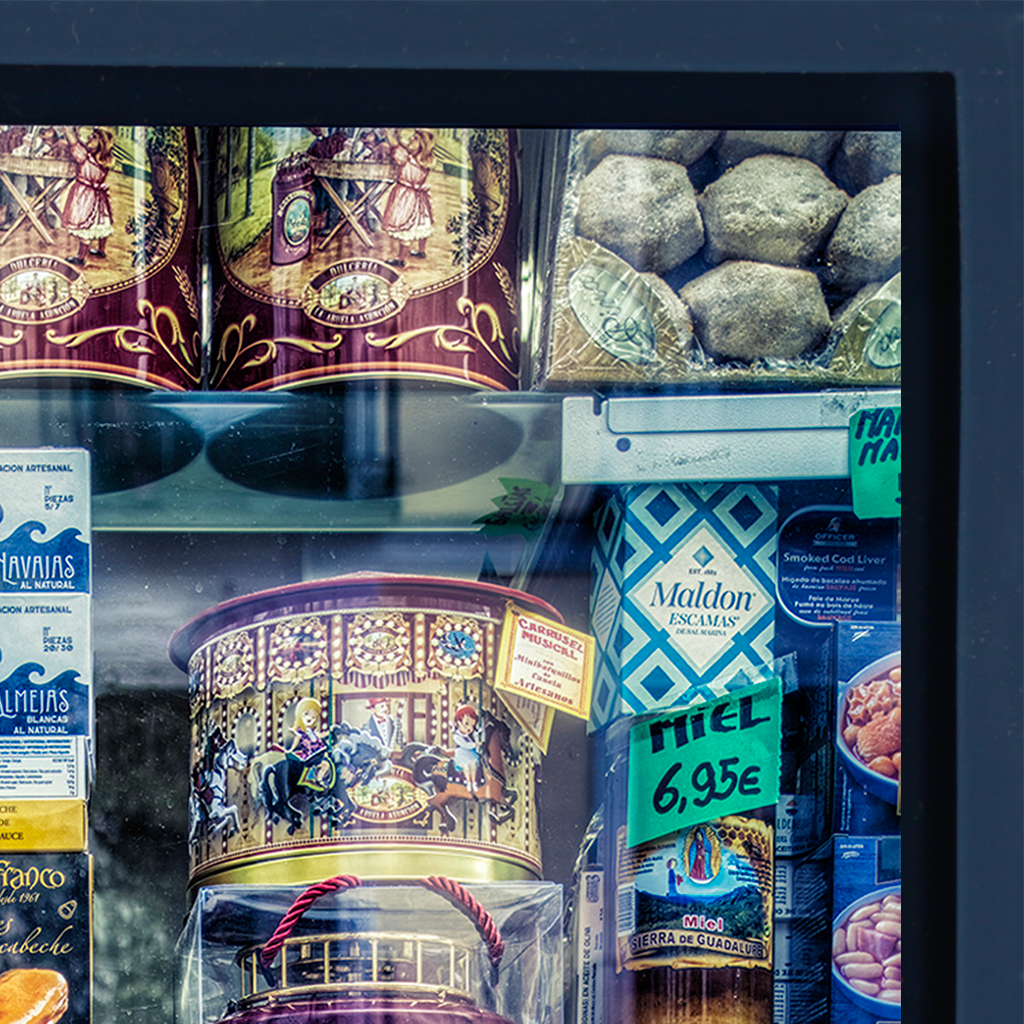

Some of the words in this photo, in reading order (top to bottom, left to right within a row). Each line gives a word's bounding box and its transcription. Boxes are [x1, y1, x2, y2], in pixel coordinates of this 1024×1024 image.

[25, 464, 73, 473] ARTESANAL
[783, 552, 830, 563] Smoked
[831, 554, 855, 564] Cod
[857, 555, 887, 564] Liver
[20, 581, 33, 589] AL
[34, 580, 75, 589] NATURAL
[650, 581, 753, 611] Maldon
[24, 605, 72, 614] ARTESANAL
[669, 612, 736, 628] ESCAMAS
[518, 618, 584, 654] CARRUSEL
[521, 630, 578, 661] MUSICAL
[514, 678, 574, 705] Artesanos
[26, 715, 69, 723] BLANCAS
[13, 726, 26, 735] AL
[27, 725, 68, 735] NATURAL
[683, 915, 724, 932] Miel
[630, 931, 676, 950] SIERRA
[679, 934, 696, 945] DE
